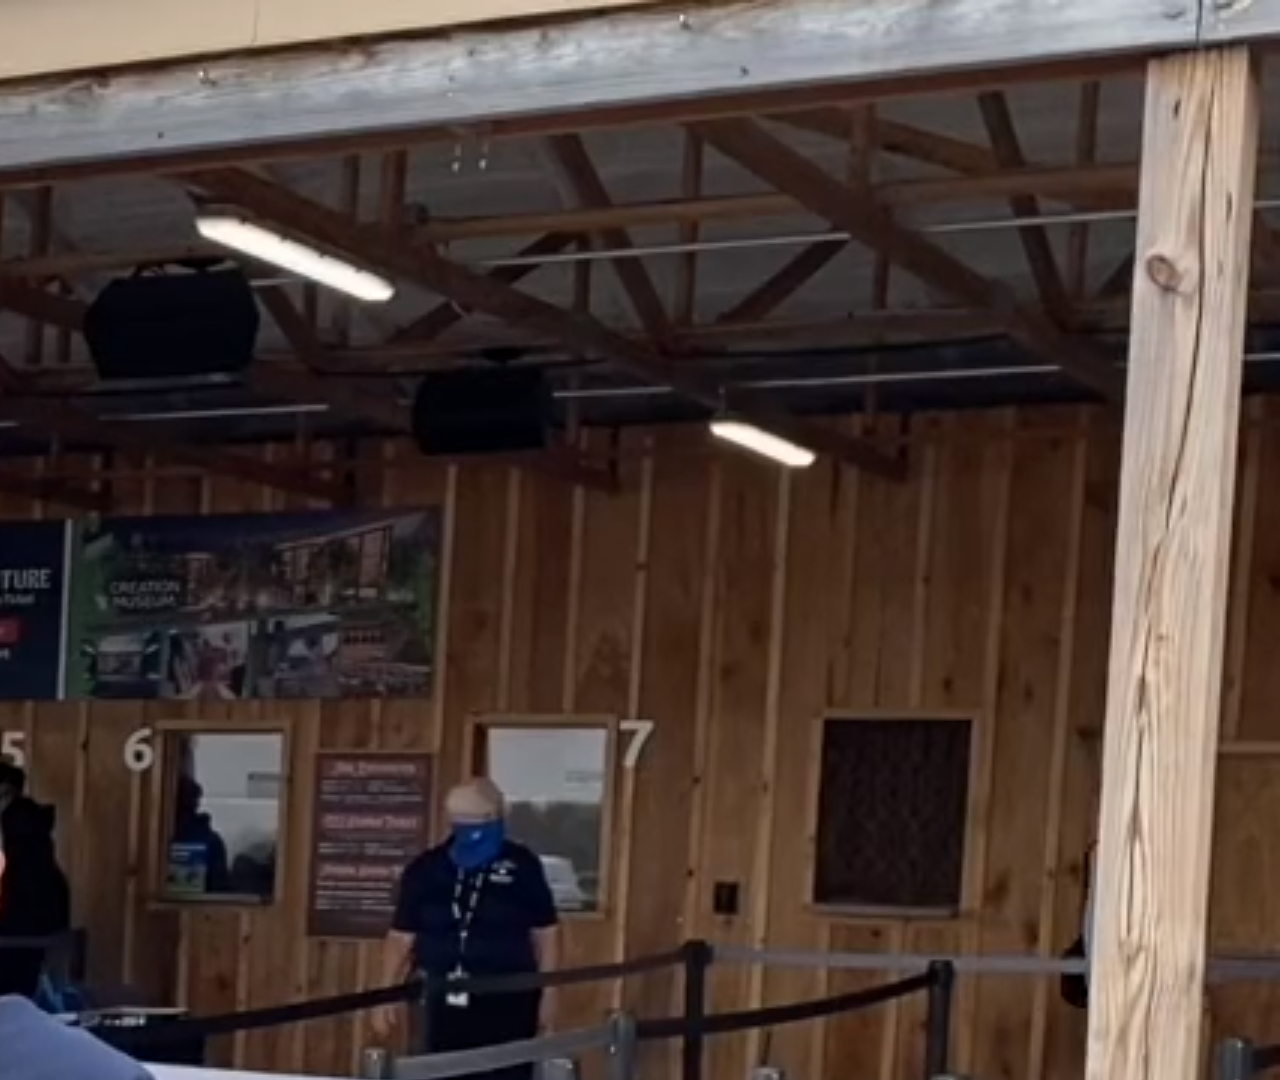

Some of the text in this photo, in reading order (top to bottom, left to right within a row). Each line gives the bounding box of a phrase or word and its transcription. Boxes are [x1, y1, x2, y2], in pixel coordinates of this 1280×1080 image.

[0, 731, 26, 767] 5
[123, 730, 155, 773] 6
[620, 719, 655, 767] 7
